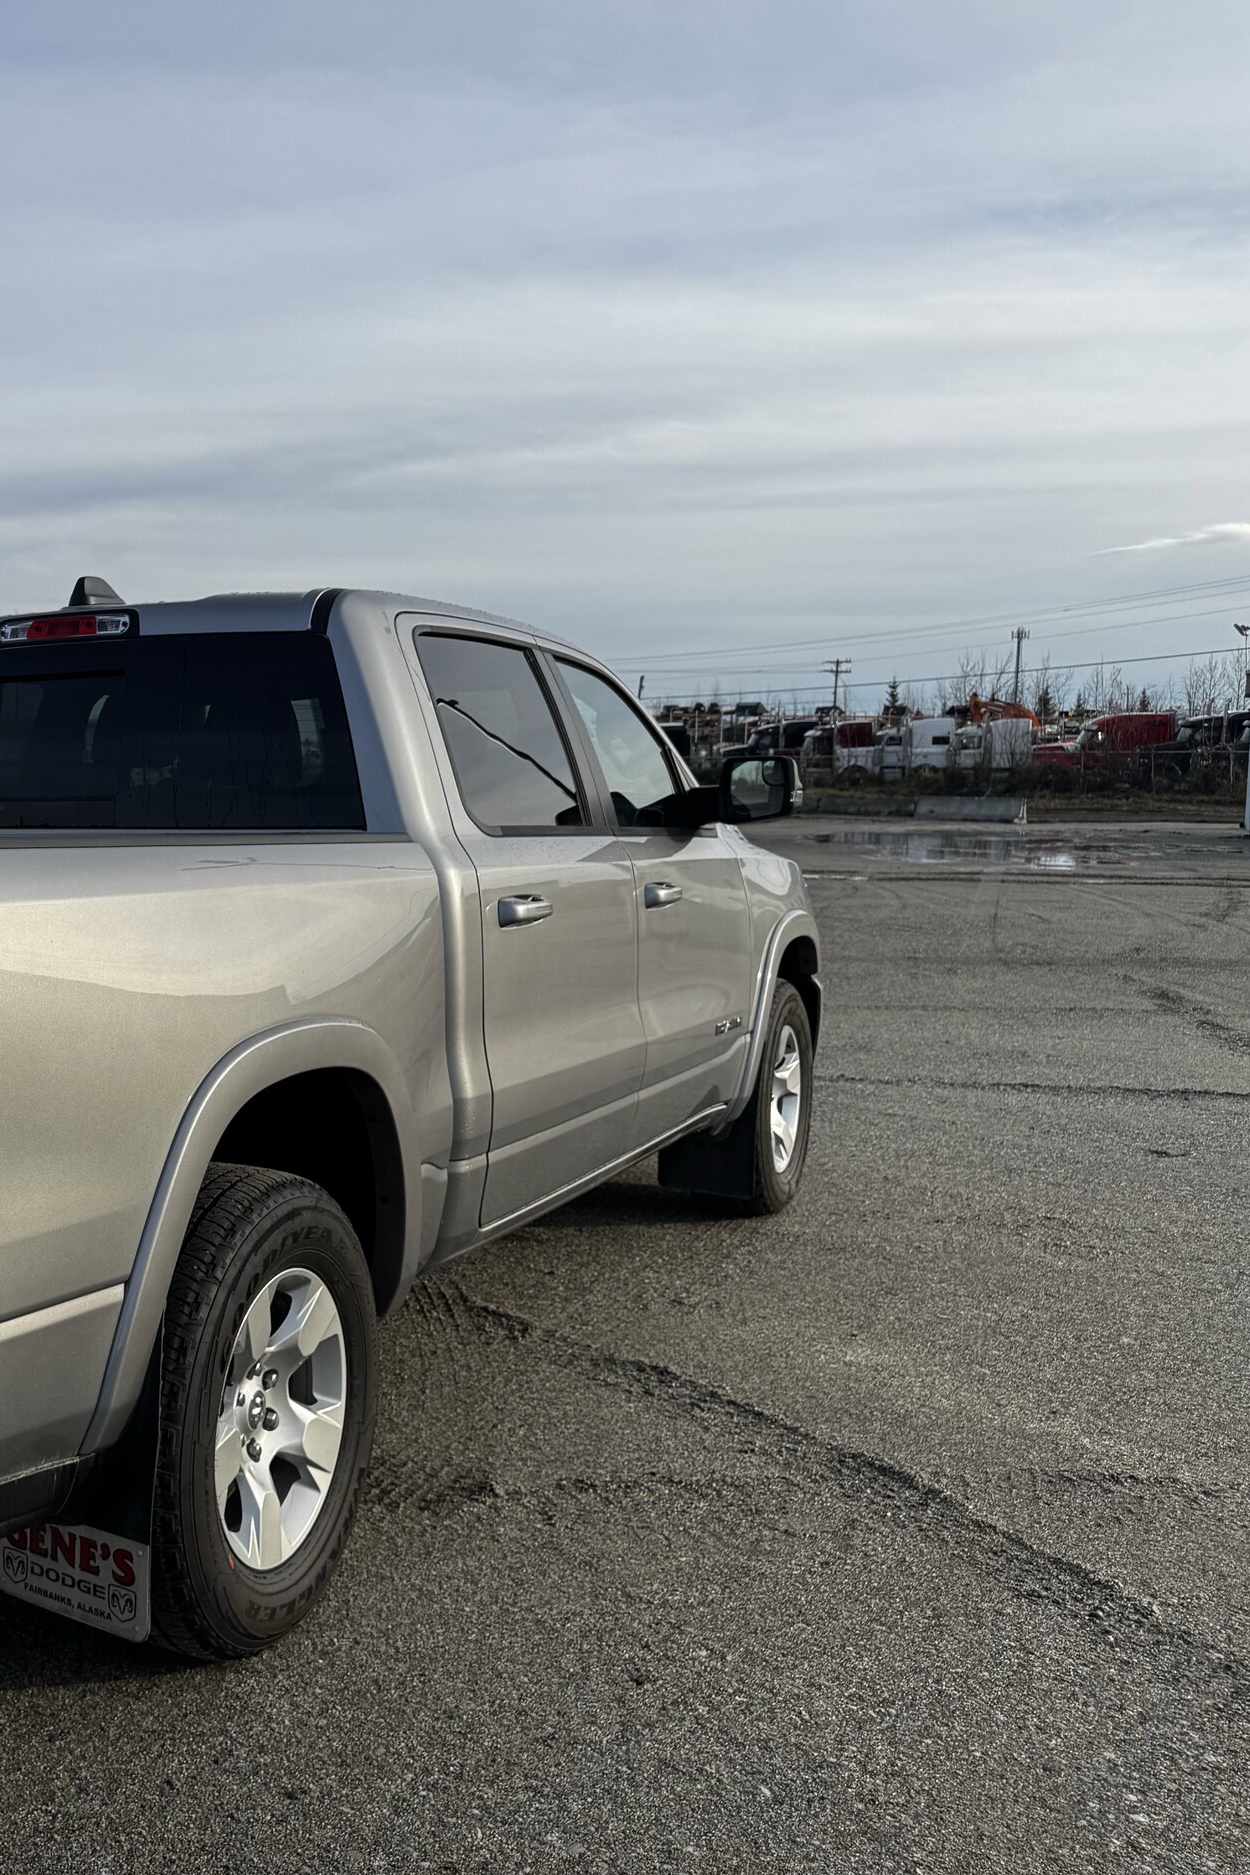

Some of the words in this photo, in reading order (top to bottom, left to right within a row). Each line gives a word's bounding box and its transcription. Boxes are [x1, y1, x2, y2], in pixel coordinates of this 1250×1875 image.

[30, 1561, 106, 1600] DODGE
[24, 1582, 74, 1609] FAIRBANKS,
[77, 1601, 112, 1621] ALASKA
